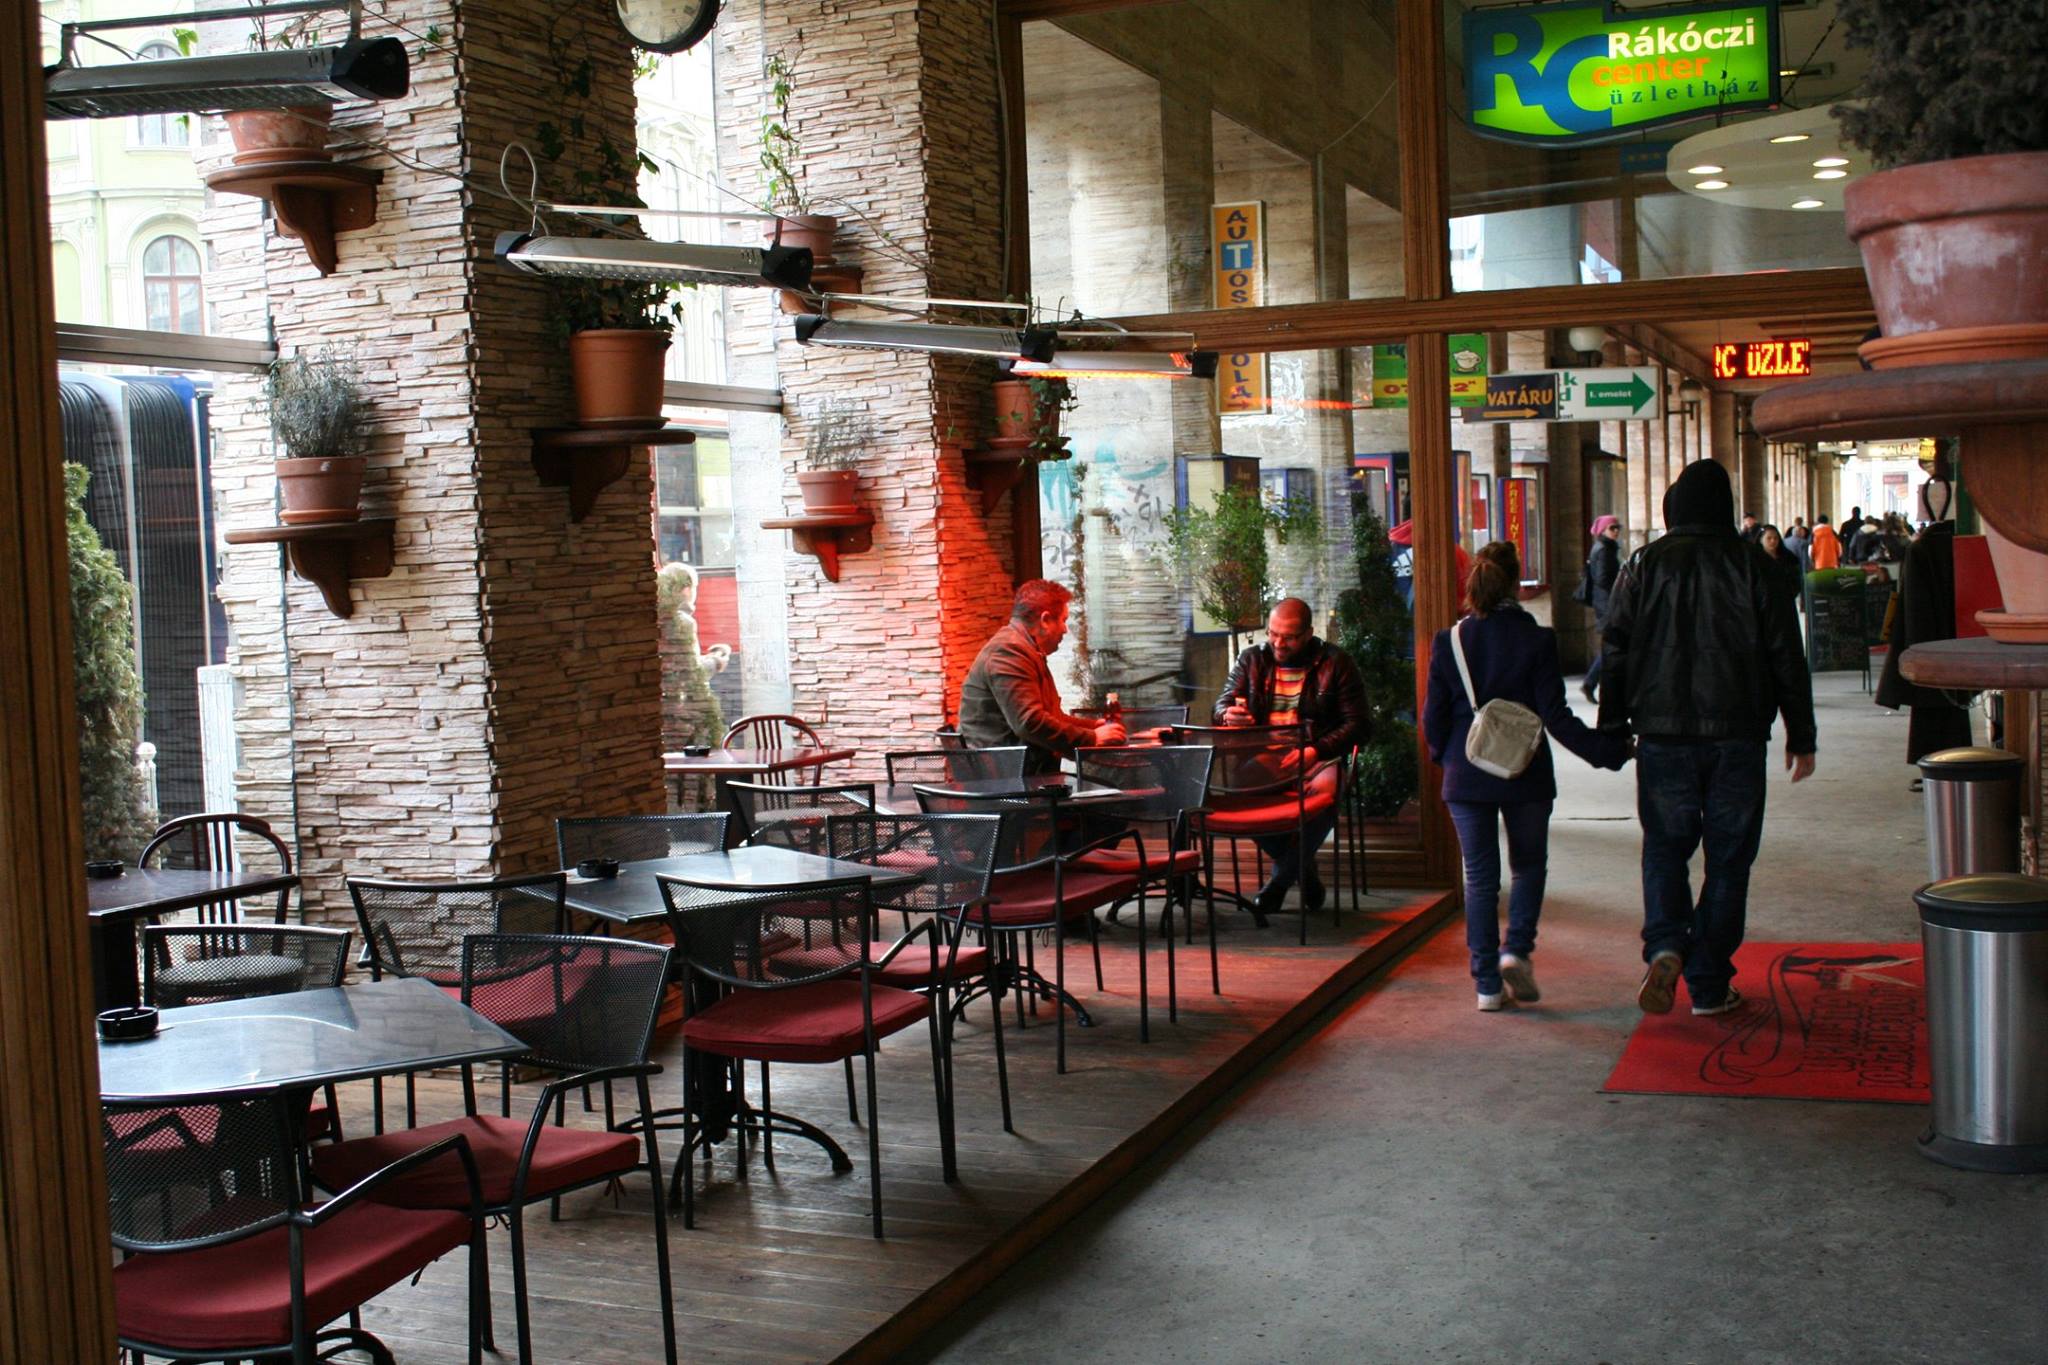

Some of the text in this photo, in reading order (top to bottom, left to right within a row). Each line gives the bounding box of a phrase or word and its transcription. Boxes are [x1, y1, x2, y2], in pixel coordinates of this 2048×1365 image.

[1608, 17, 1755, 60] Rákóczi
[1592, 55, 1712, 88] center
[1610, 77, 1759, 105] üzletház
[1487, 384, 1553, 407] VATÁRU
